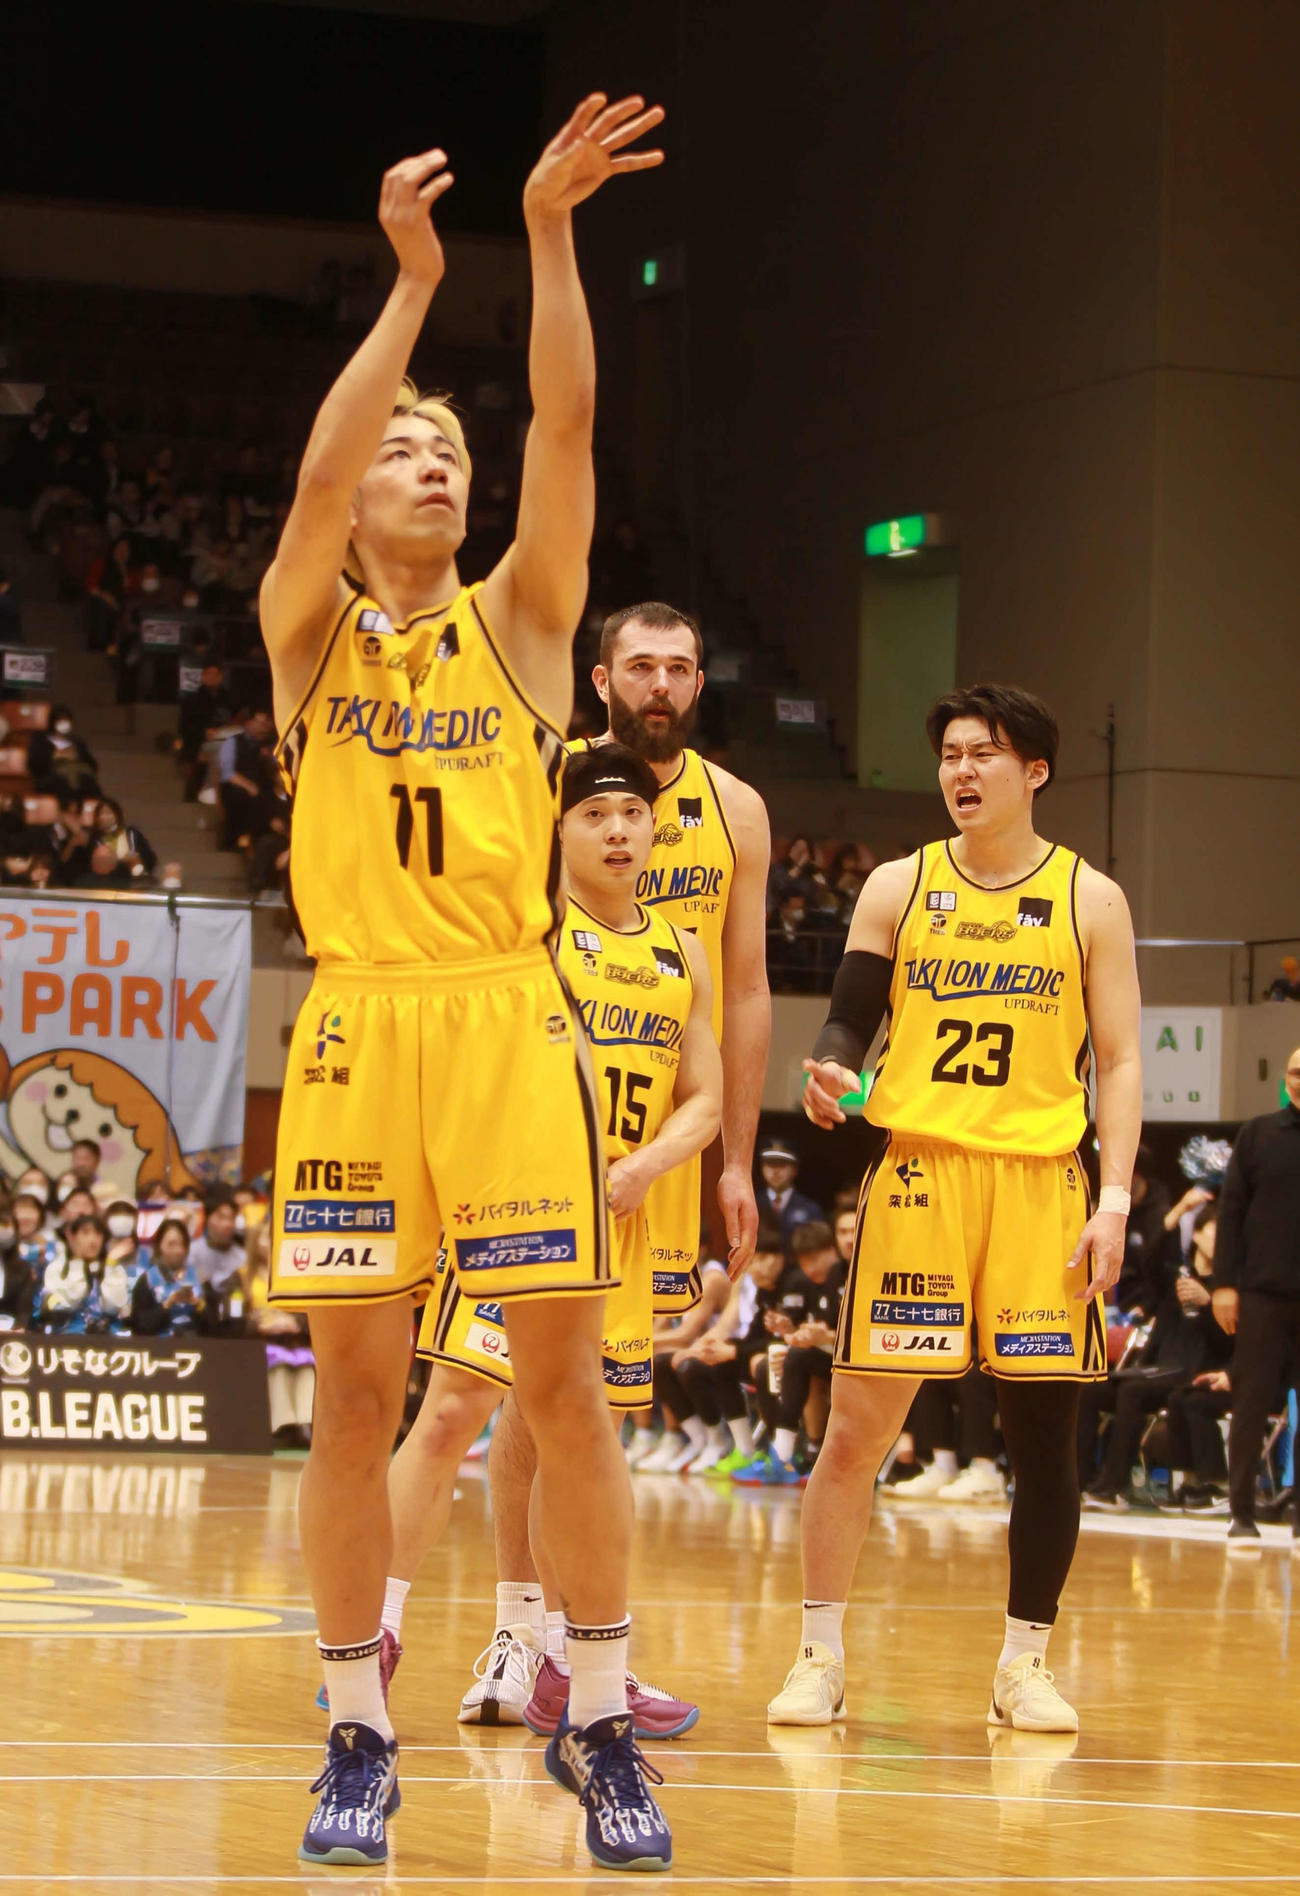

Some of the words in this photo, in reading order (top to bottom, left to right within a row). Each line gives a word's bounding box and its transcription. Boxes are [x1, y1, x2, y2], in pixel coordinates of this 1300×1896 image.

[390, 783, 444, 877] 11
[991, 963, 1064, 997] MEDIC
[21, 970, 218, 1043] PARK
[1004, 998, 1060, 1016] UPDRAFT
[931, 1018, 1014, 1087] 23
[604, 1066, 653, 1145] 15
[316, 1247, 377, 1266] JAL
[880, 1272, 925, 1296] MTG
[927, 1290, 948, 1298] Group
[928, 1282, 955, 1290] TOYOTA
[875, 1303, 890, 1316] 77
[893, 1307, 961, 1322] 七十七銀行
[903, 1336, 952, 1351] JAL
[37, 1347, 202, 1378] りそなグループ
[0, 1389, 208, 1442] B.LEAGUE
